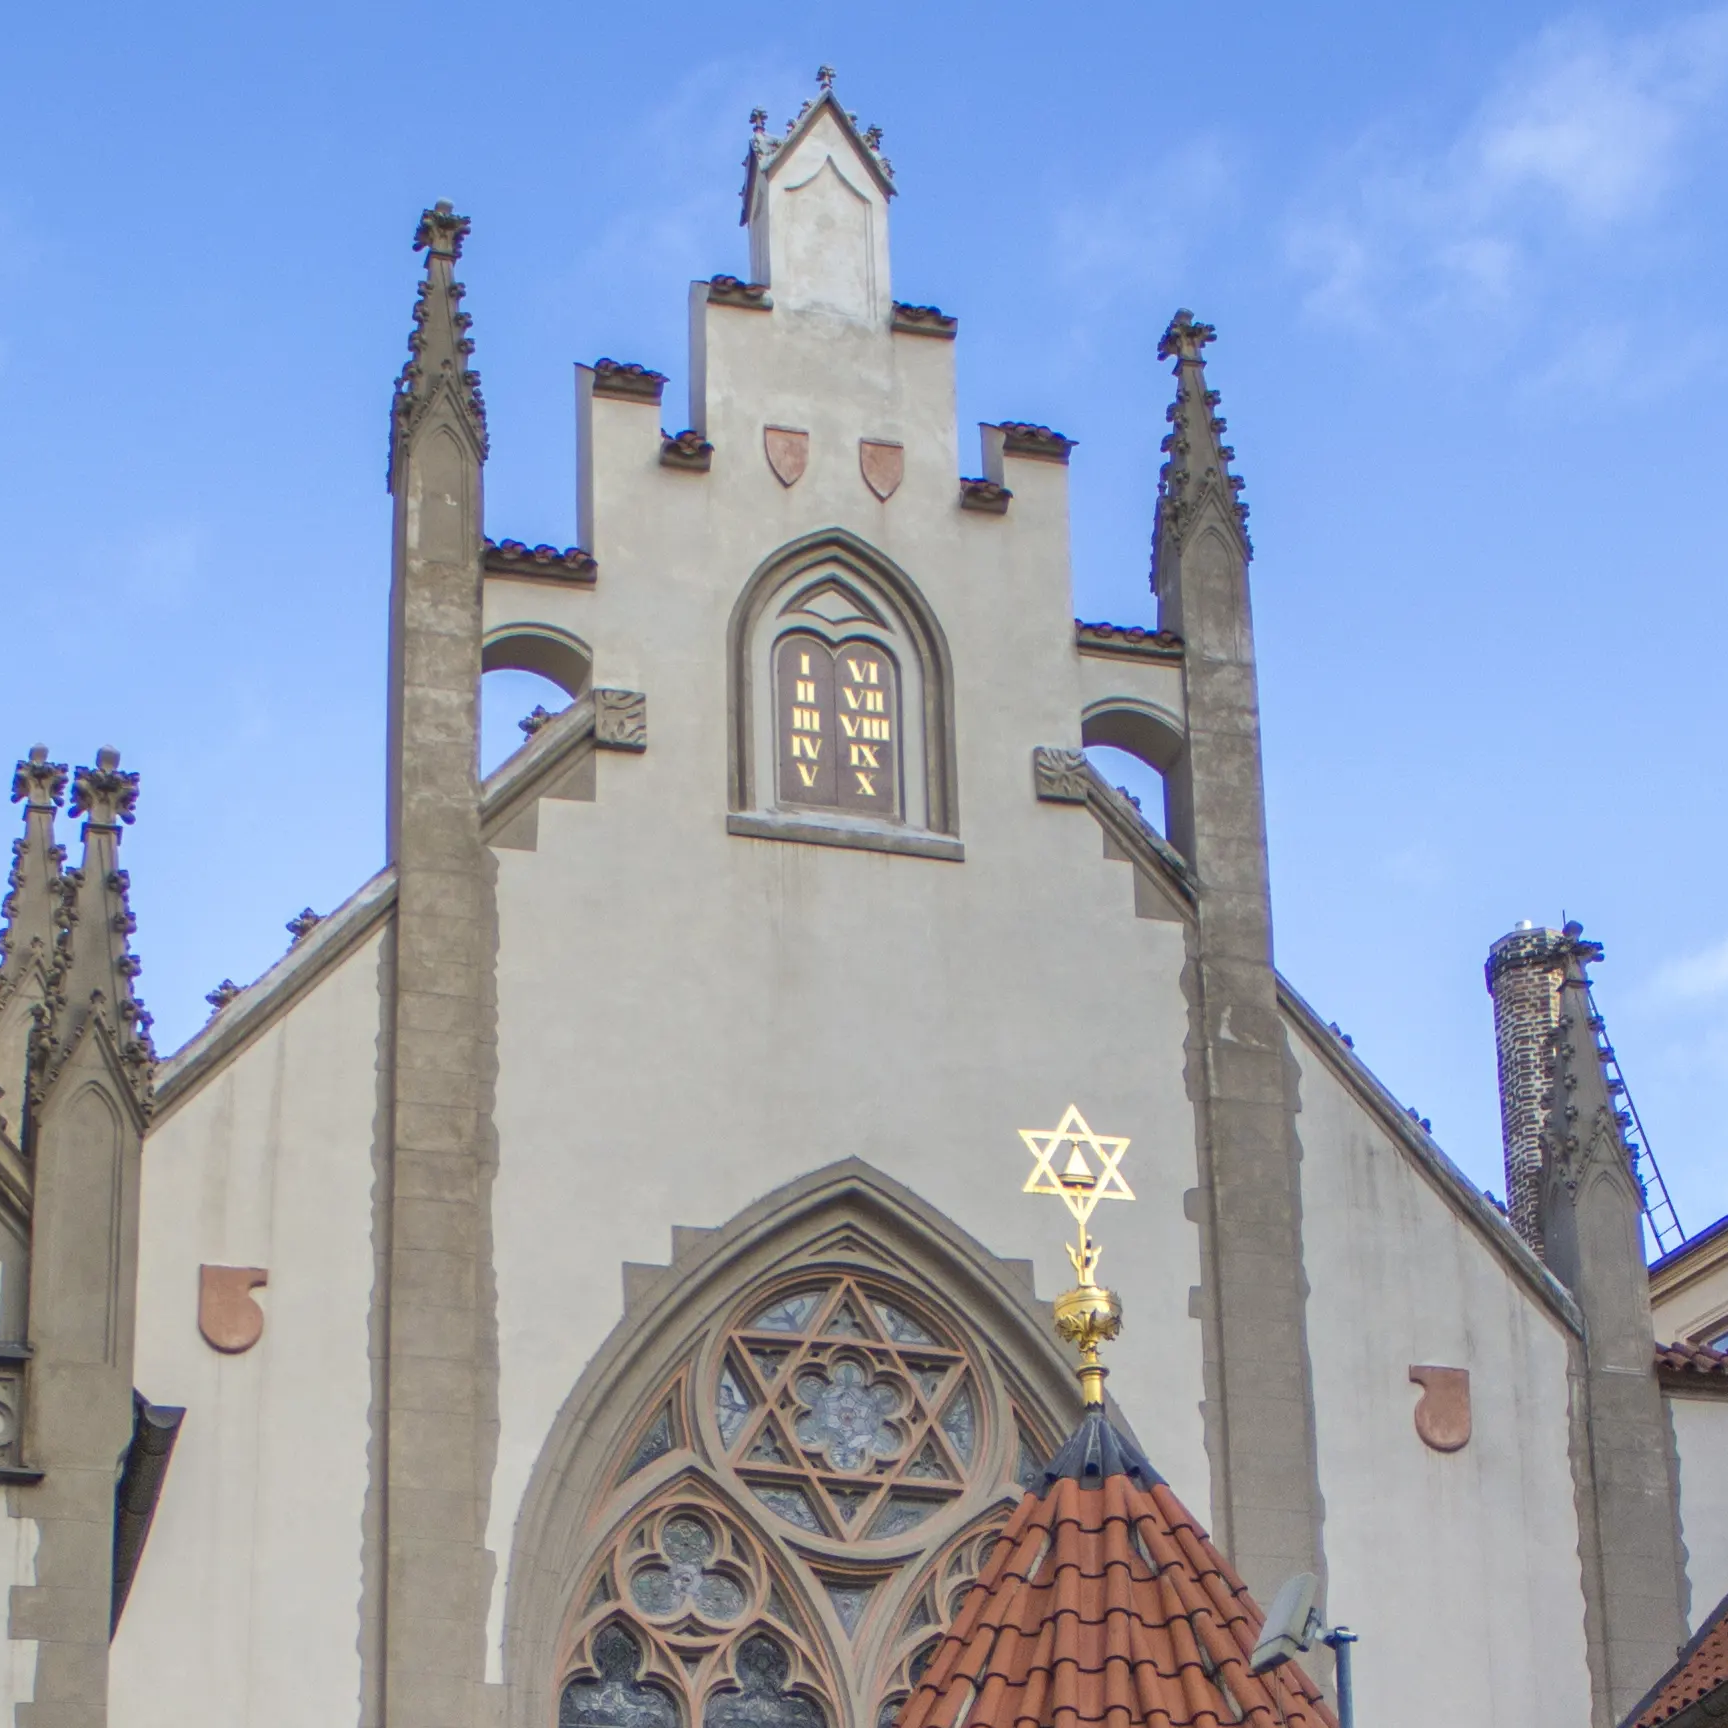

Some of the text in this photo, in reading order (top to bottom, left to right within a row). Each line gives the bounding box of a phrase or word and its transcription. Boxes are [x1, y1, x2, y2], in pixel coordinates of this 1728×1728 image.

[800, 653, 810, 676] I
[847, 659, 878, 685] VI
[796, 680, 815, 703] II
[843, 687, 884, 713] VII
[792, 707, 821, 732] III
[840, 715, 890, 741] VIII
[792, 735, 822, 760] IV
[850, 744, 880, 769] IX
[796, 763, 819, 787] V
[855, 772, 877, 797] X
